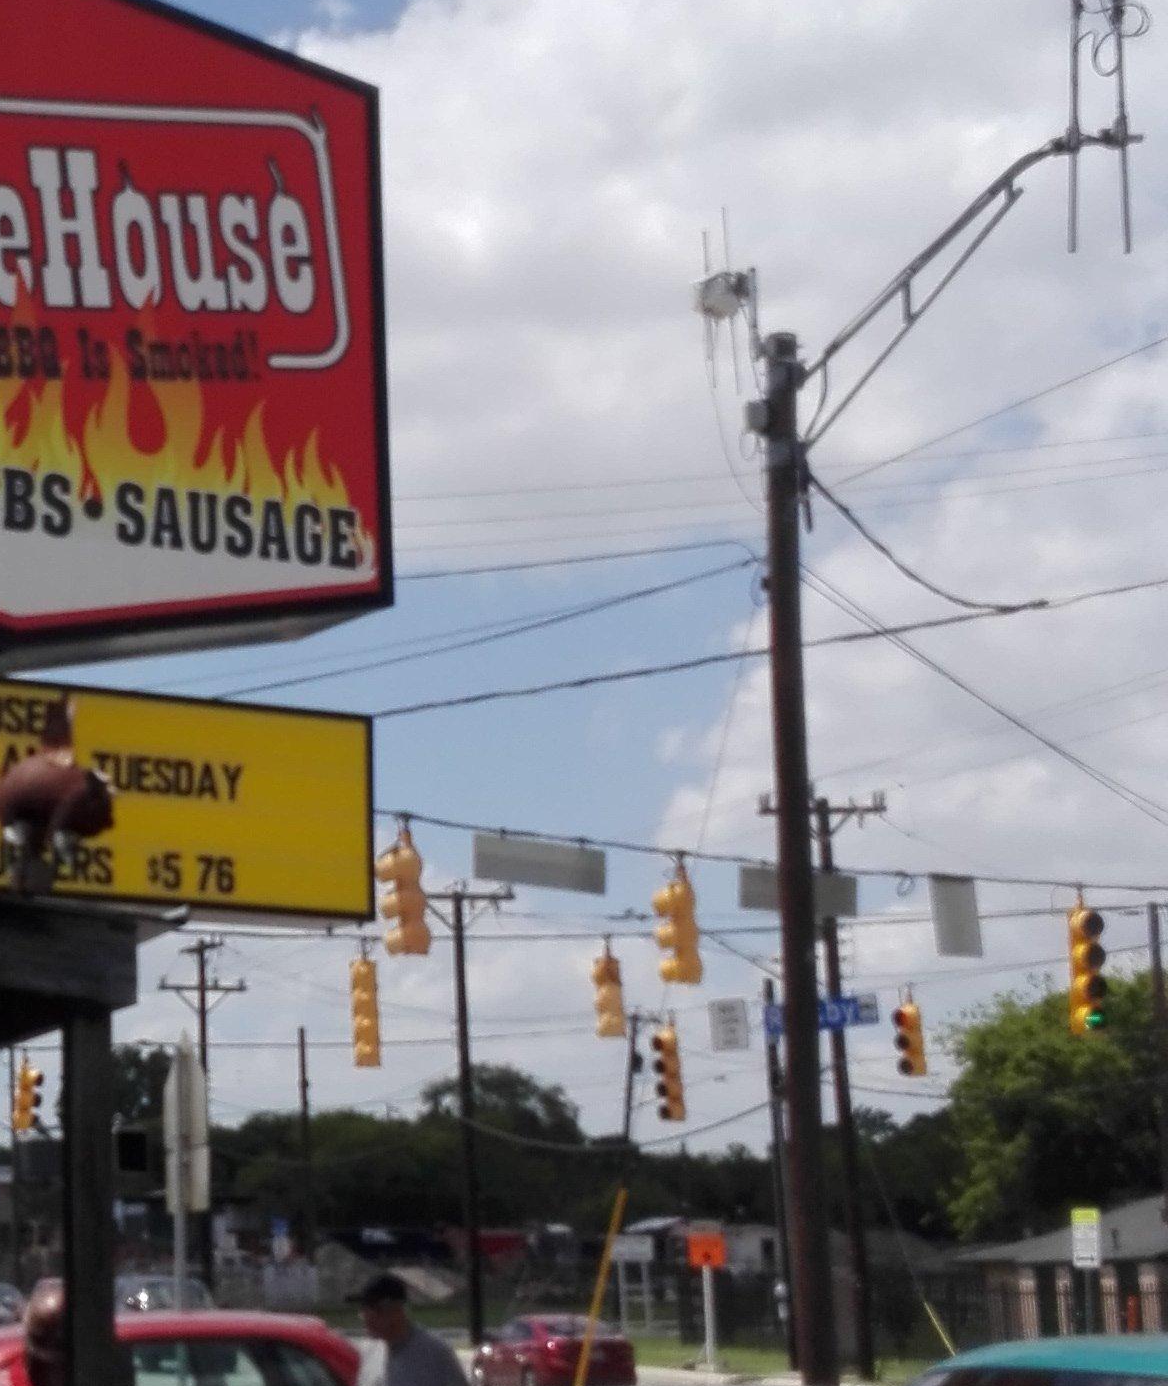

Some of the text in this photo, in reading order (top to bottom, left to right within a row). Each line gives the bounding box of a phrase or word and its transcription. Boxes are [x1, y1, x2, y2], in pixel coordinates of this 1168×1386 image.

[77, 327, 112, 381] Is
[126, 327, 264, 383] Smoked!
[116, 480, 358, 569] SAUSAGE
[92, 750, 243, 803] TUESDAY
